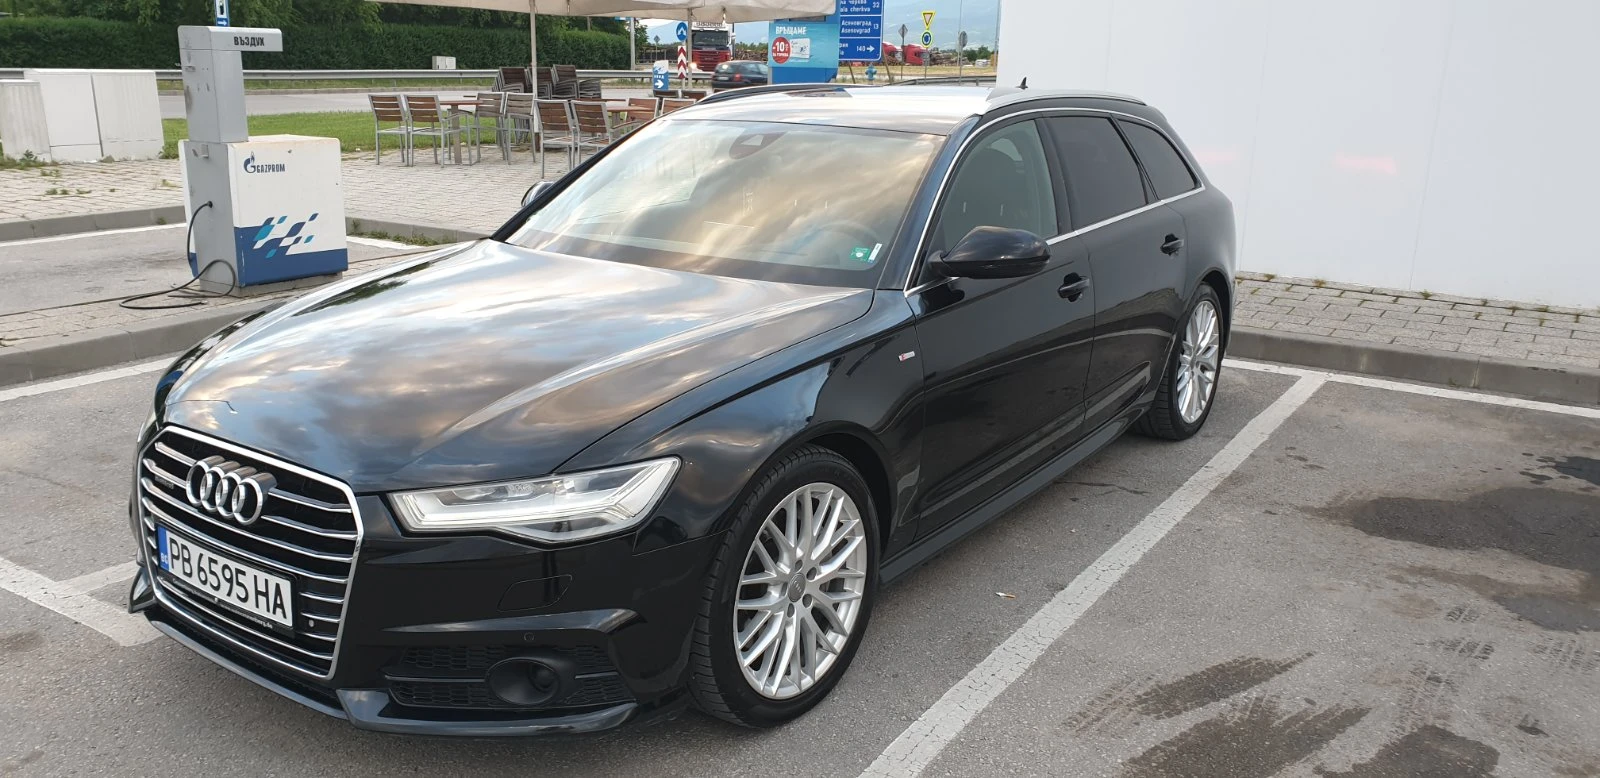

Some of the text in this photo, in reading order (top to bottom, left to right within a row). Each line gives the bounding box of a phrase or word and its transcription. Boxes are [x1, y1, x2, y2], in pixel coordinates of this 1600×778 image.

[775, 26, 807, 35] ВРЪЩАМЕ
[233, 36, 265, 47] ВЪЗДУХ
[256, 163, 286, 173] GAZPROM
[169, 537, 193, 578] PB
[197, 552, 249, 604] 6595
[253, 574, 288, 620] HA
